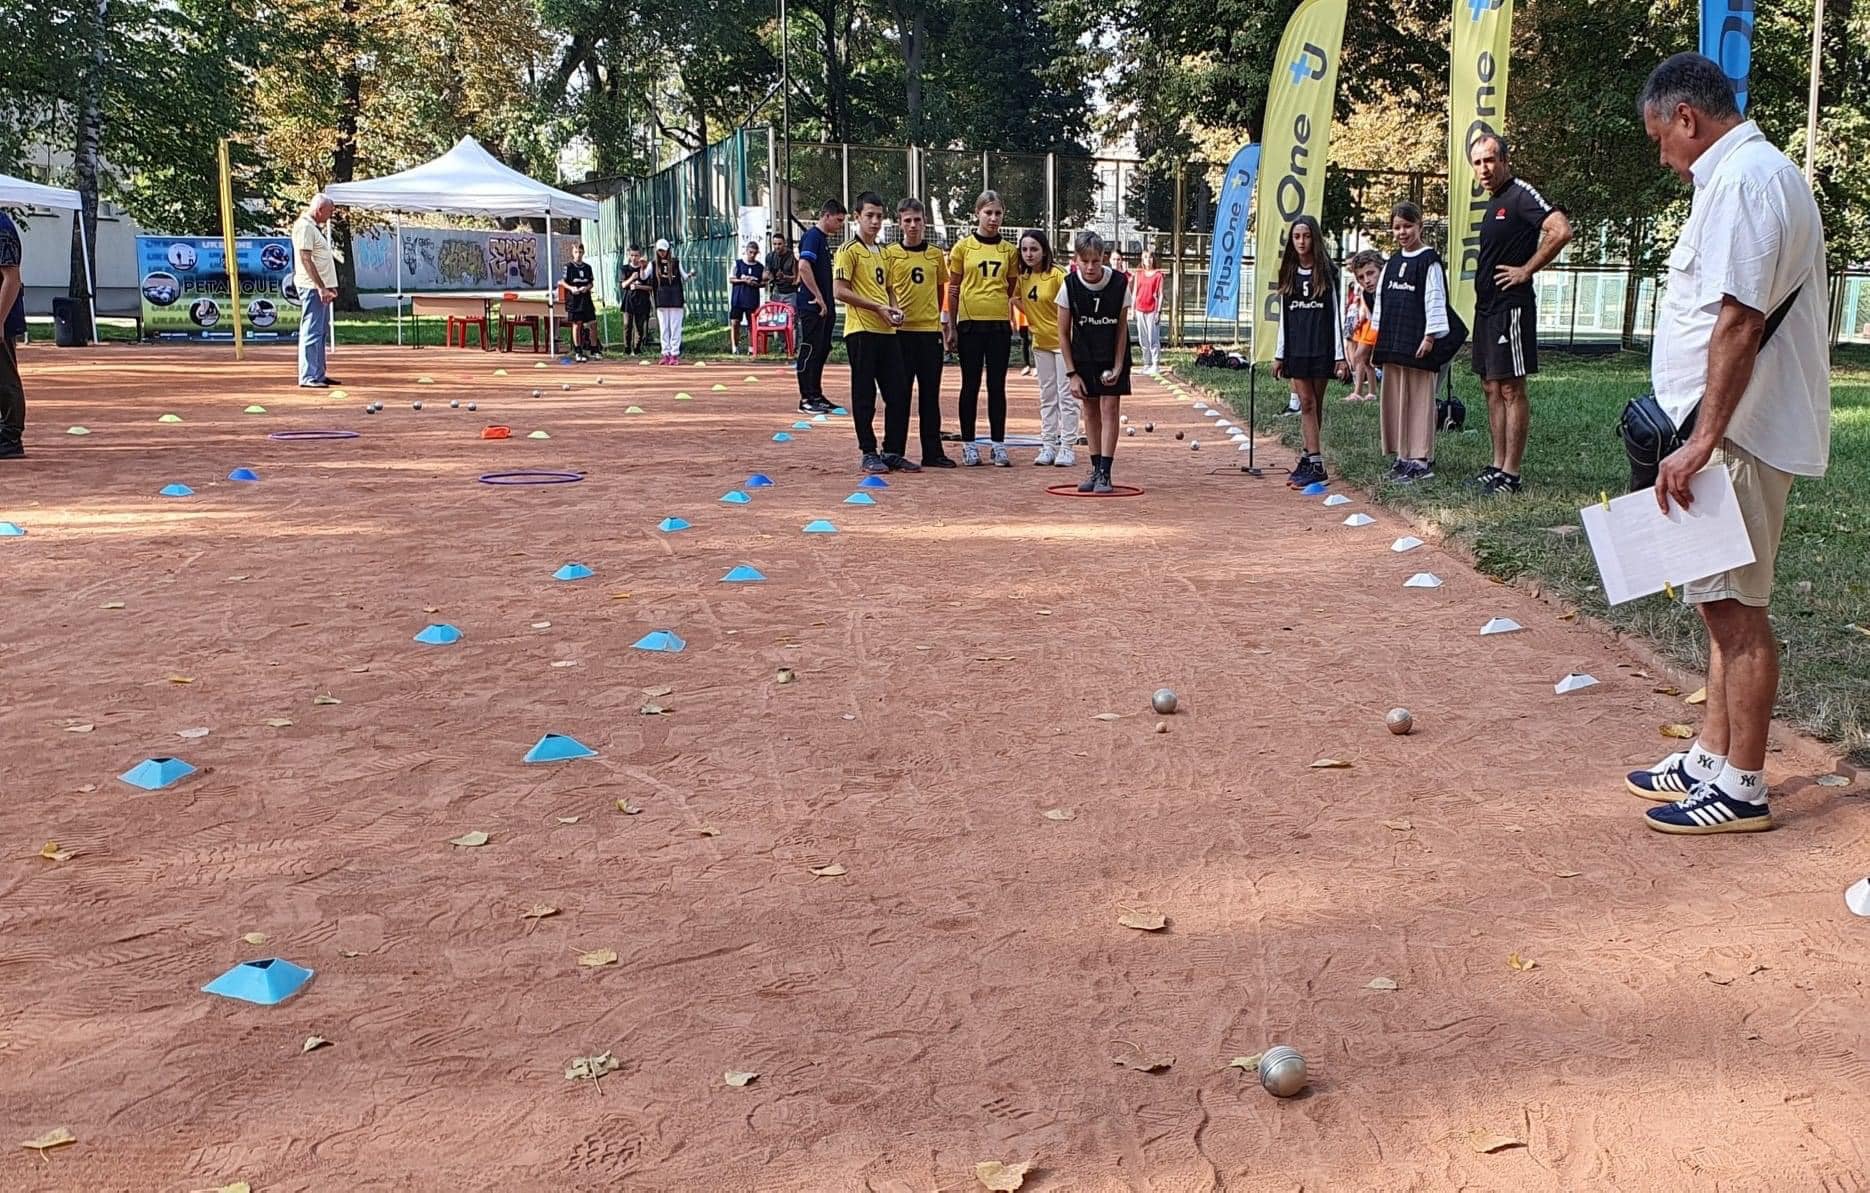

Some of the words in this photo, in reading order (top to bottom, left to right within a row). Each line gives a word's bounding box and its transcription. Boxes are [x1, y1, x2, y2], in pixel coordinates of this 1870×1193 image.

[1213, 202, 1241, 304] PlusOne
[875, 266, 885, 285] 8
[911, 267, 925, 284] 6
[978, 261, 1002, 277] 17
[1028, 286, 1039, 302] 4
[1302, 281, 1309, 297] 5
[1093, 298, 1100, 312] 7
[1089, 316, 1118, 325] PlusOne
